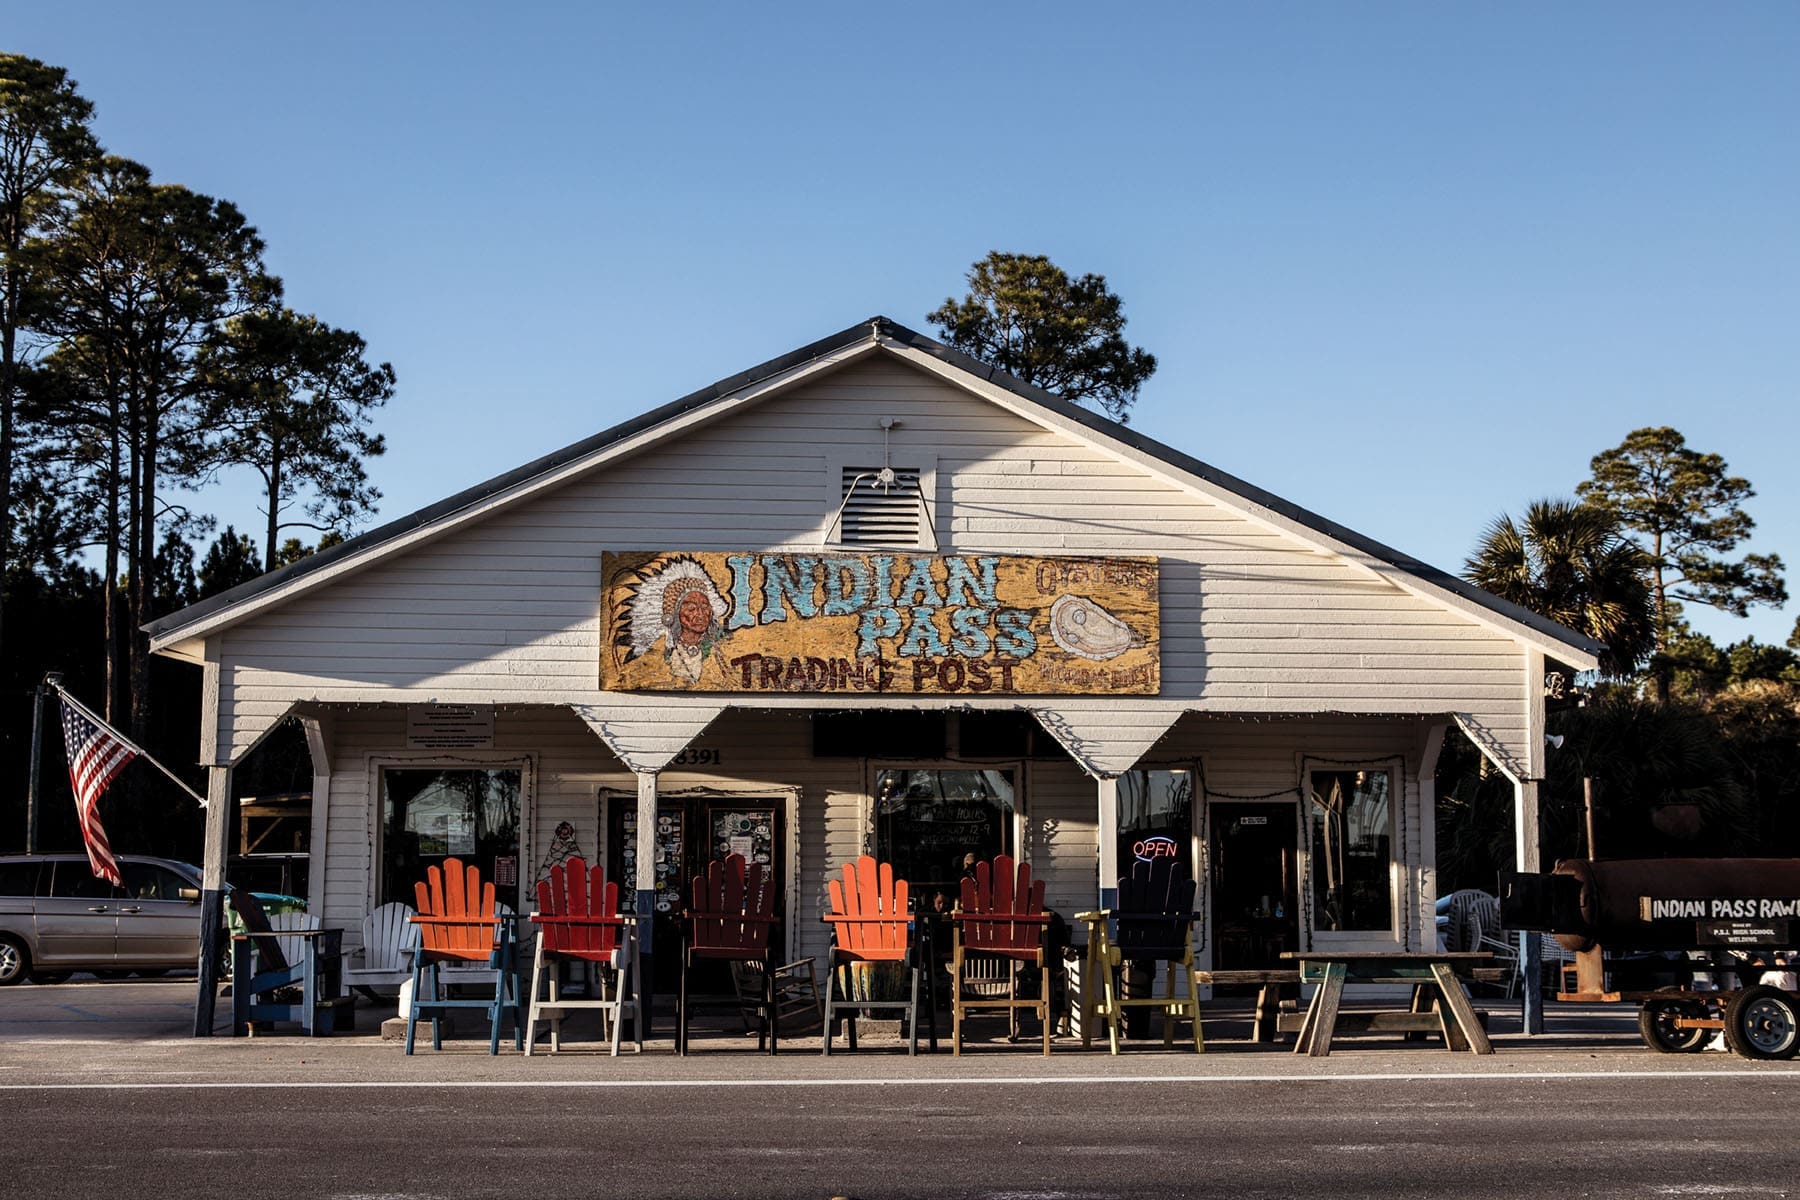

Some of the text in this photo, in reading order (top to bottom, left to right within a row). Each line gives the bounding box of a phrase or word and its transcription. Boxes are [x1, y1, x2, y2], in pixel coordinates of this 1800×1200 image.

[725, 555, 1000, 630] INDIAN
[1036, 560, 1154, 595] OYSTERS
[857, 606, 1037, 658] PASS
[730, 653, 1020, 692] TRADING POST
[1133, 841, 1177, 857] OPEN
[1653, 899, 1705, 918] INDIAN
[1711, 899, 1757, 918] PASS
